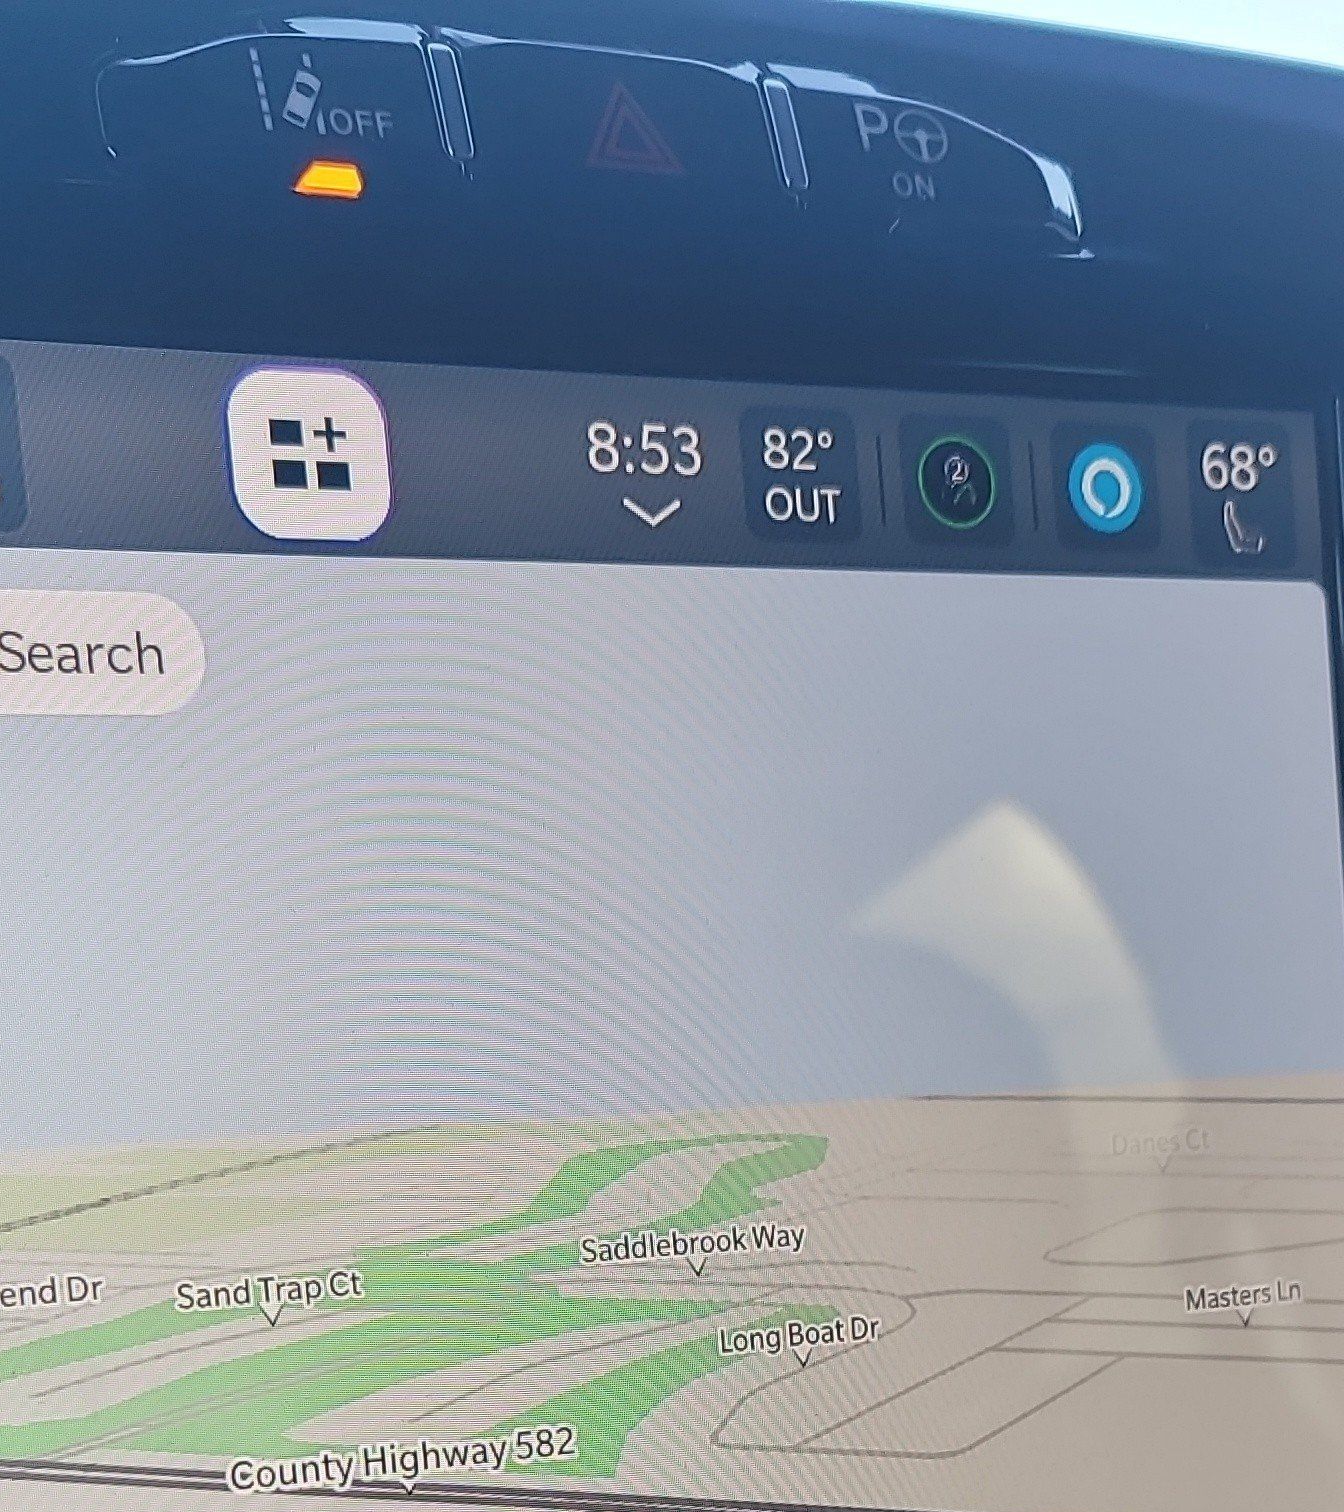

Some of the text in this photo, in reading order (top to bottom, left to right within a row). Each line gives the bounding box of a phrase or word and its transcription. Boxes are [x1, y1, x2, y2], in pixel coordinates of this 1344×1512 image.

[328, 107, 394, 140] OFF
[892, 170, 937, 201] ON
[587, 419, 703, 476] 8:53
[761, 427, 835, 473] 82°
[763, 485, 842, 526] OUT
[581, 1224, 806, 1264] Saddlebrook Way
[66, 1276, 102, 1302] Dr
[177, 1272, 362, 1311] Sand Trap Ct
[1186, 1281, 1302, 1311] Masters Ln
[720, 1318, 879, 1355] Long Boat Dr
[230, 1426, 575, 1492] County Highway 582
